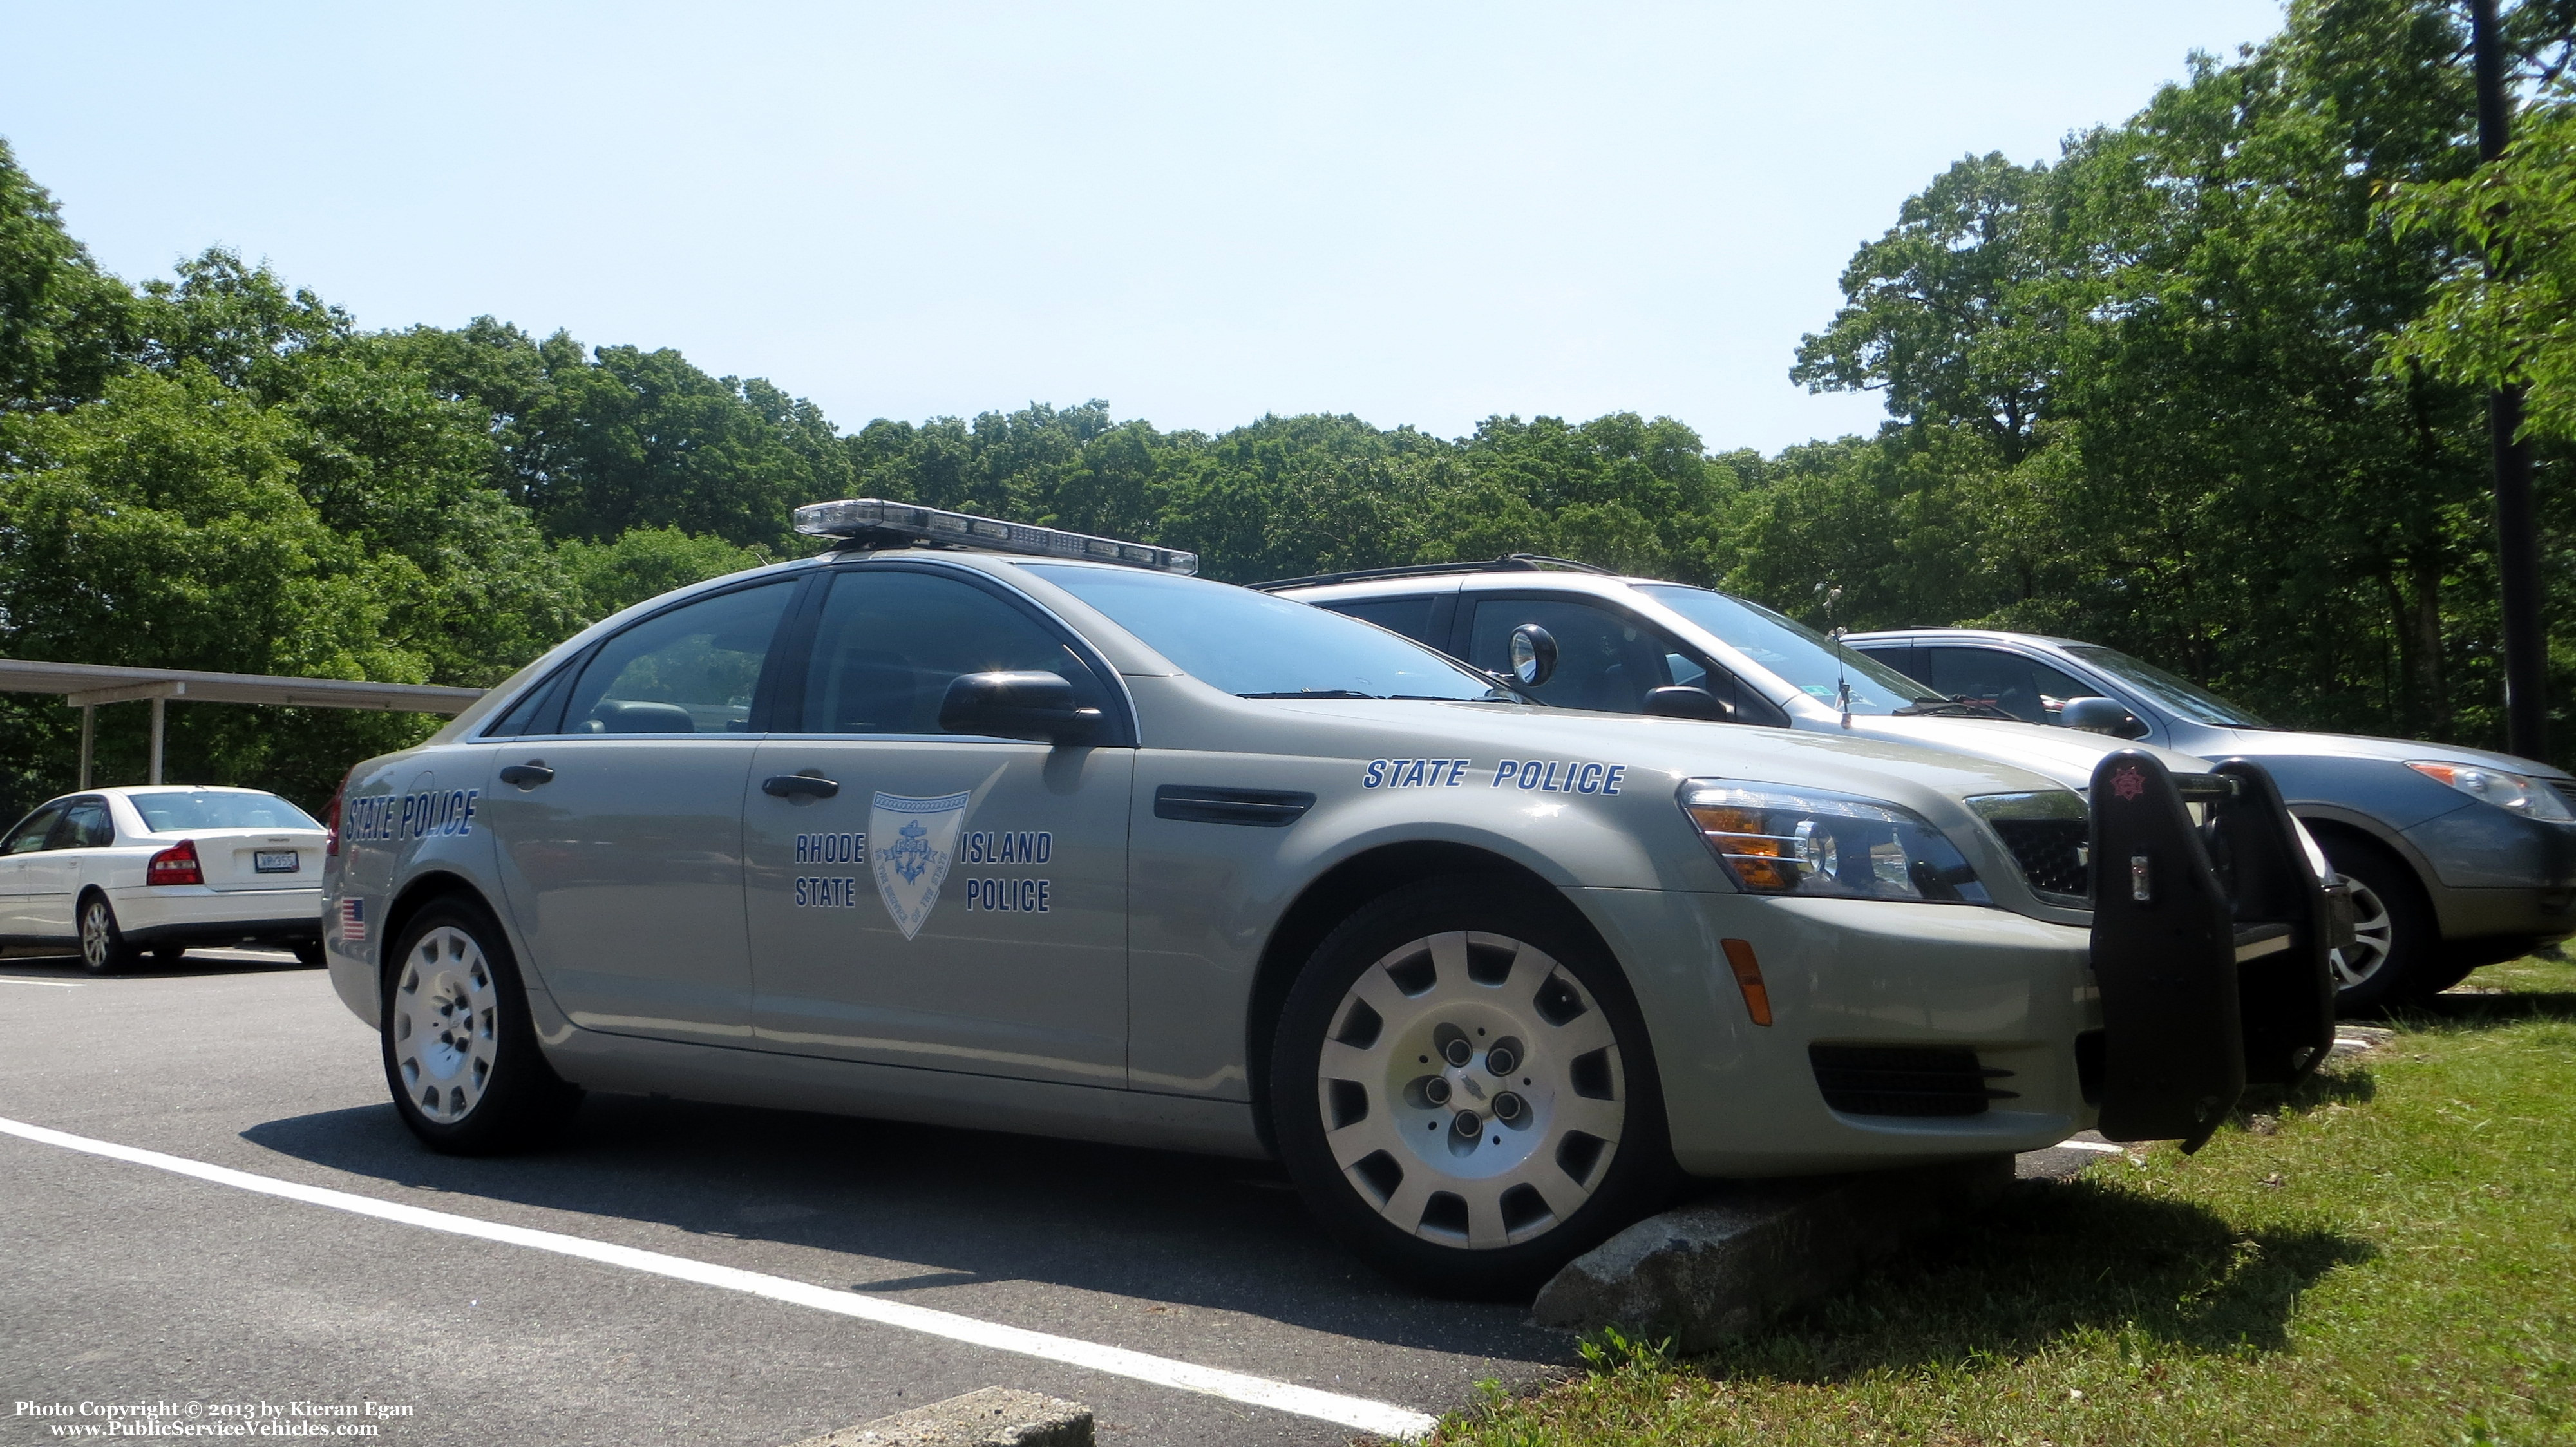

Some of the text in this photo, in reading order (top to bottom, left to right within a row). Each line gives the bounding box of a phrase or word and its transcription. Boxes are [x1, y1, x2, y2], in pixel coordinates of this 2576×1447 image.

[1362, 759, 1627, 795] STATE POLICE
[346, 788, 480, 842] STATE POLICE
[795, 831, 1053, 865] RHODE ISLAND
[899, 840, 923, 850] HOPE
[795, 876, 1050, 913] STATE POLICE
